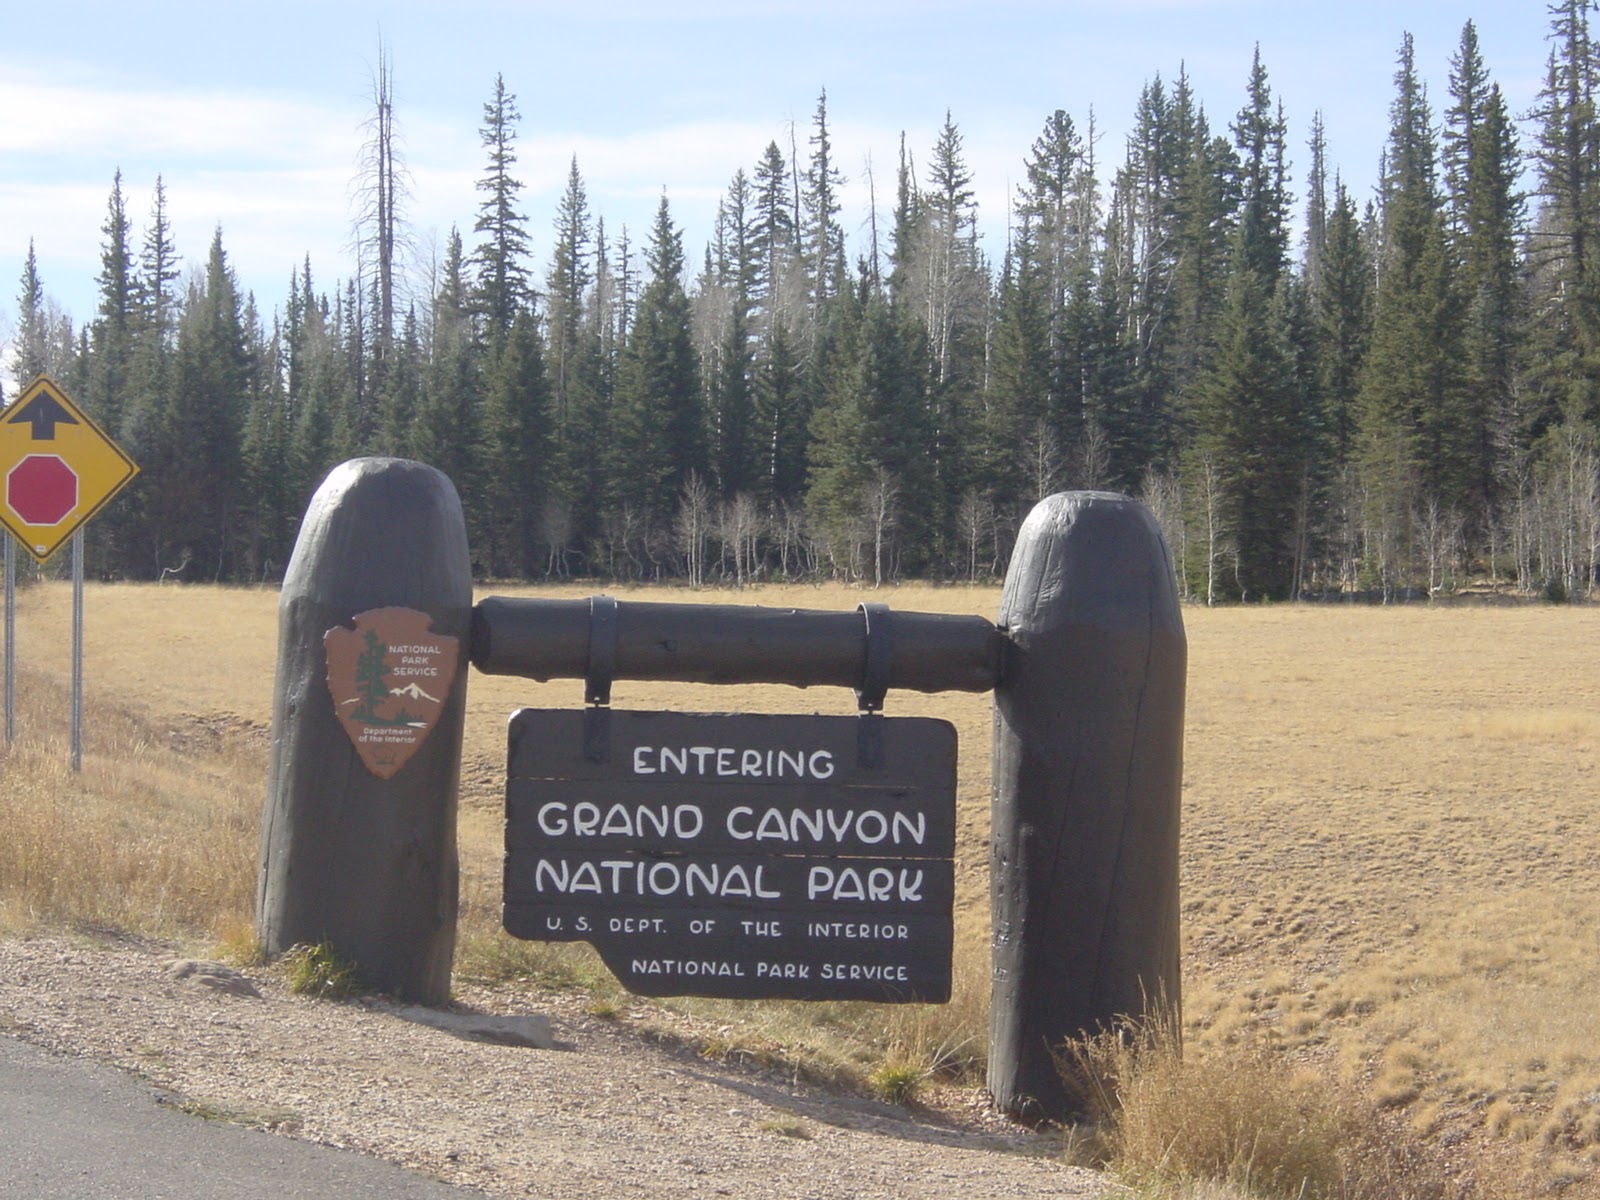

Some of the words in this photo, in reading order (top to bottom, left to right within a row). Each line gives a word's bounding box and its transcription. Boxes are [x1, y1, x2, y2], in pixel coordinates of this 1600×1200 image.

[388, 645, 441, 654] NATIONAL
[401, 656, 429, 665] PARK
[393, 667, 437, 676] SERVICE
[363, 727, 412, 736] Department
[385, 736, 416, 744] Interior
[633, 746, 834, 779] ENTERING
[537, 801, 703, 839] GRAND
[726, 806, 926, 846] CANYON
[535, 859, 781, 899] NATIONAL
[808, 866, 923, 902] PARK
[609, 918, 667, 933] DEPT.
[689, 920, 715, 934] OF
[741, 921, 781, 937] THE
[808, 923, 908, 940] INTERIOR
[632, 959, 745, 977] NATIONAL
[757, 963, 809, 978] PARK
[820, 964, 908, 981] SERVICE
